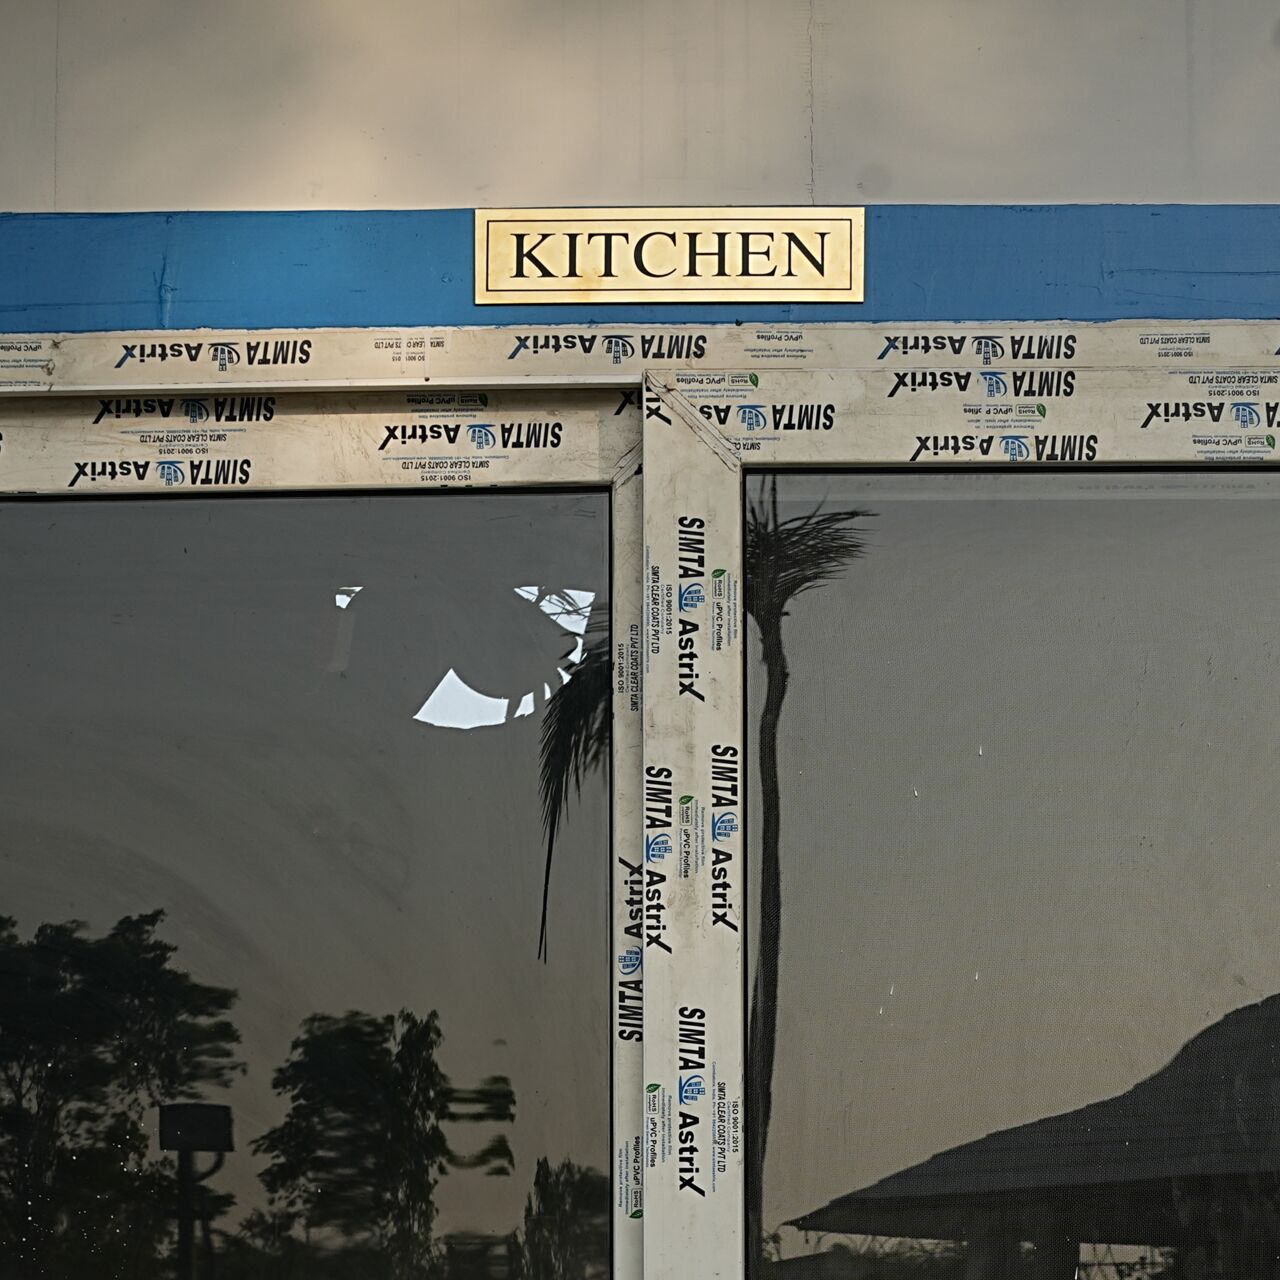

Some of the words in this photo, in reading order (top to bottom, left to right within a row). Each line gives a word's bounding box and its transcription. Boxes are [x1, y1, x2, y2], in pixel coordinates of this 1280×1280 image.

[509, 231, 831, 279] KITCHEN
[247, 340, 311, 365] SIMTA
[641, 335, 706, 358] SIMTA
[1011, 335, 1076, 359] SIMTA
[1013, 371, 1075, 396] SIMTA
[215, 396, 277, 424] SIMTA
[772, 404, 835, 430] SIMTA
[501, 423, 562, 448] SIMTA
[1035, 433, 1099, 463] SIMTA
[190, 459, 251, 485] SIMTA
[678, 517, 705, 578] SIMTA
[712, 745, 738, 807] SIMTA
[646, 766, 672, 828] SIMTA
[619, 980, 643, 1042] SIMTA
[679, 1007, 705, 1070] SIMTA
